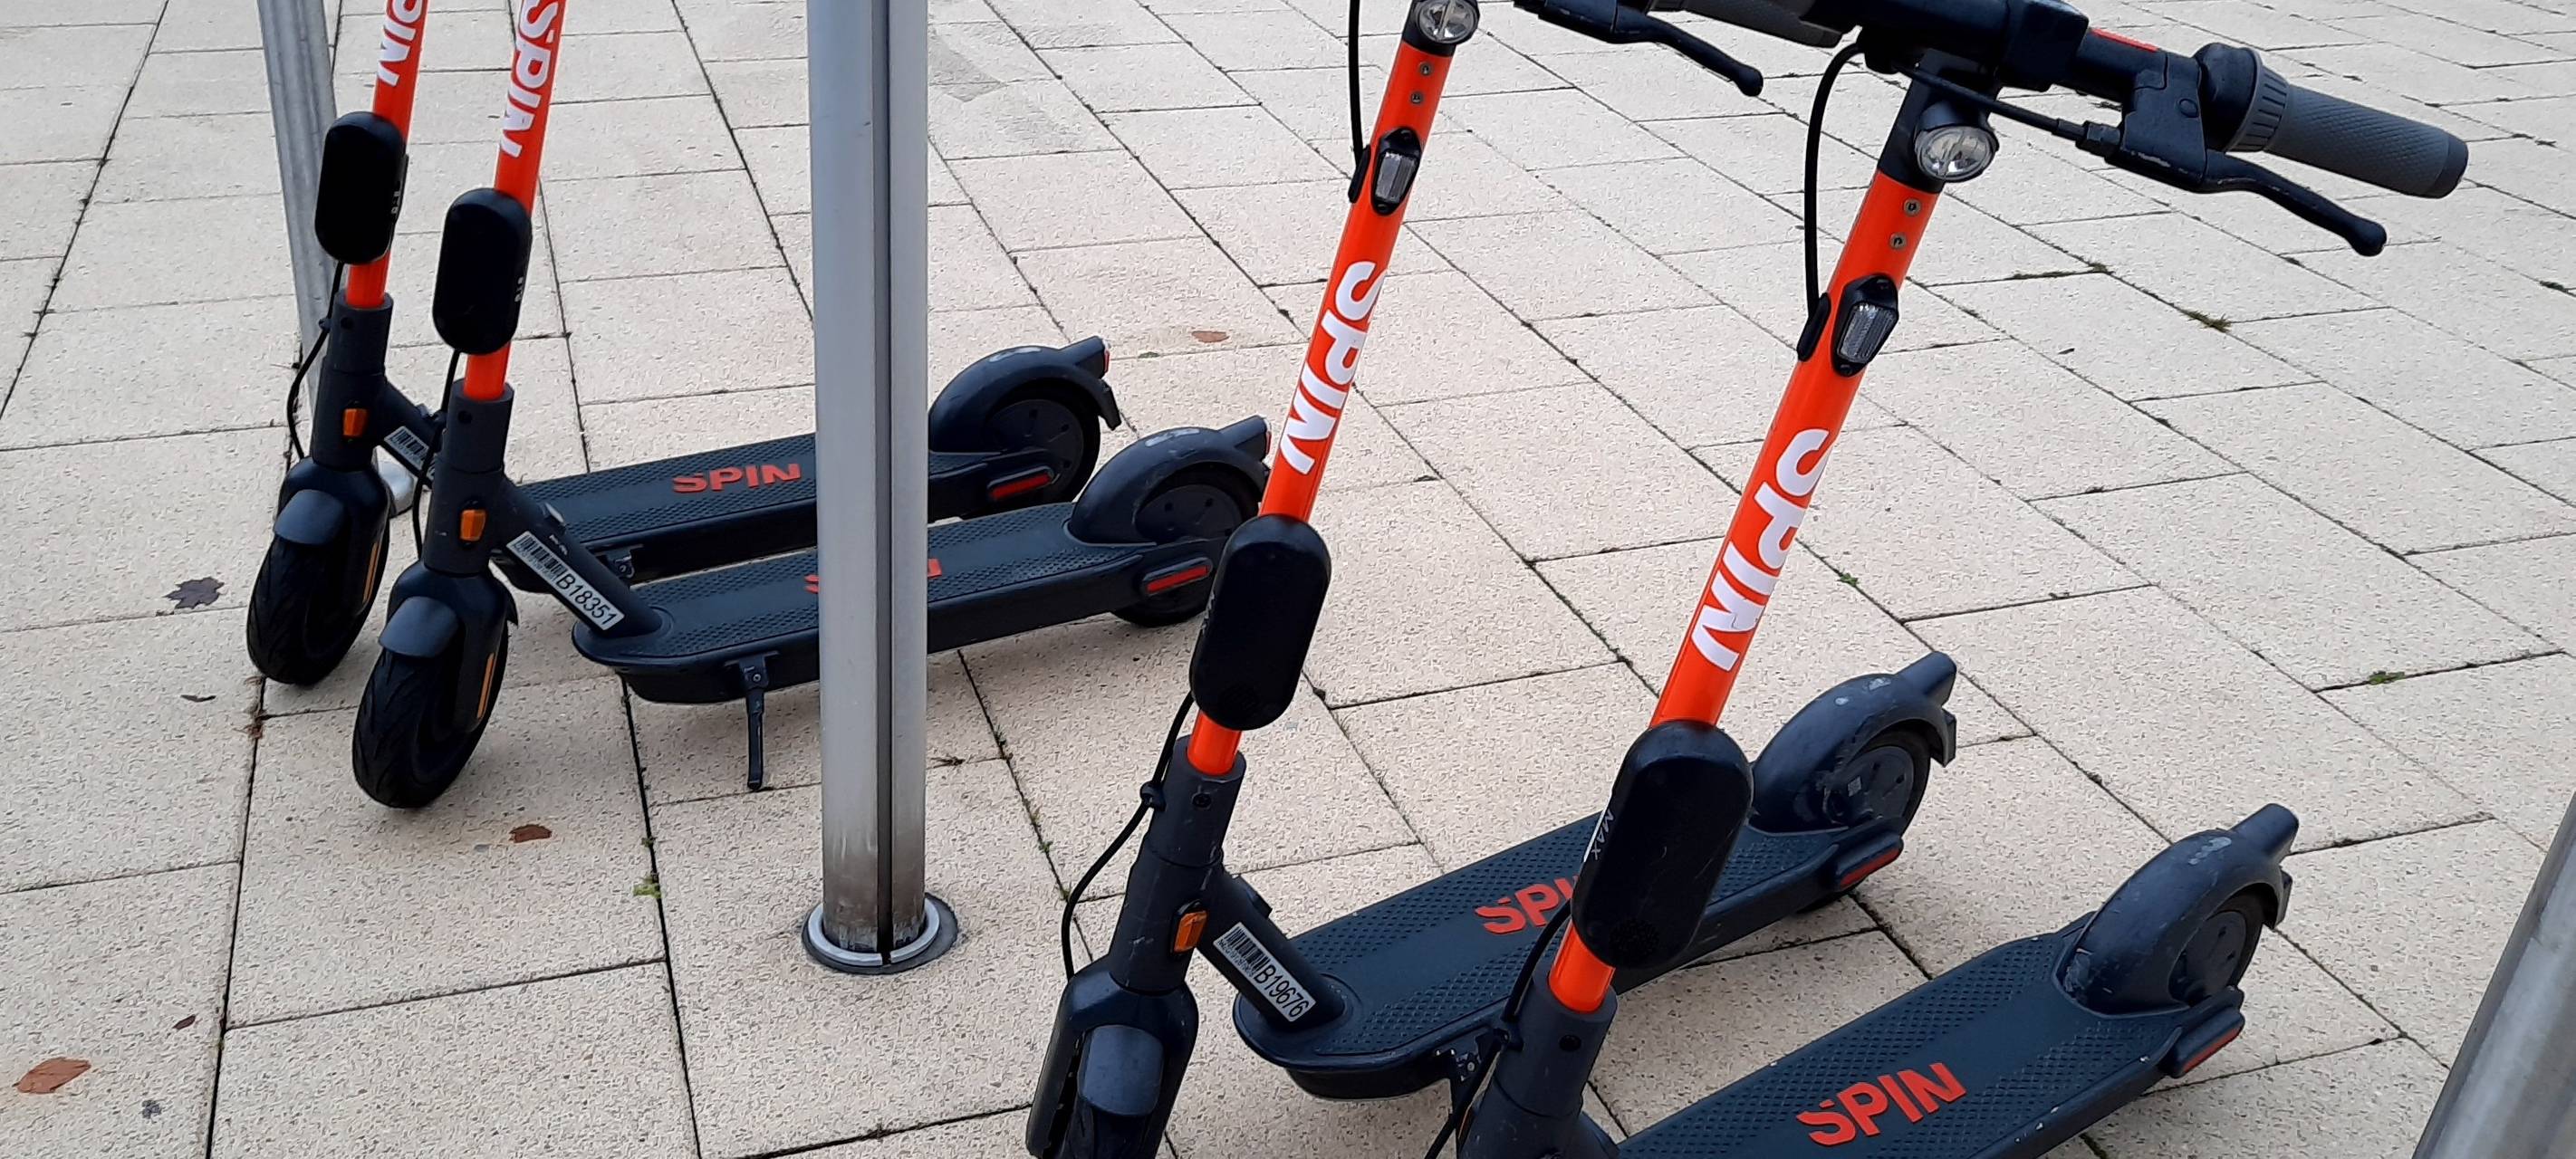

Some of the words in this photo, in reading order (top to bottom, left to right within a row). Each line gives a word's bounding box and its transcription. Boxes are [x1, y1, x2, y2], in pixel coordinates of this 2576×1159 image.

[500, 0, 558, 158] SPIN
[1280, 261, 1387, 474] SPIN
[672, 463, 802, 493] SPIN
[1691, 428, 1834, 671] SPIN
[556, 575, 617, 627] B18351
[1591, 809, 1615, 860] MAX
[1475, 875, 1579, 934] SPI
[1254, 965, 1309, 1018] B19676
[1796, 1062, 1966, 1146] SPIN
